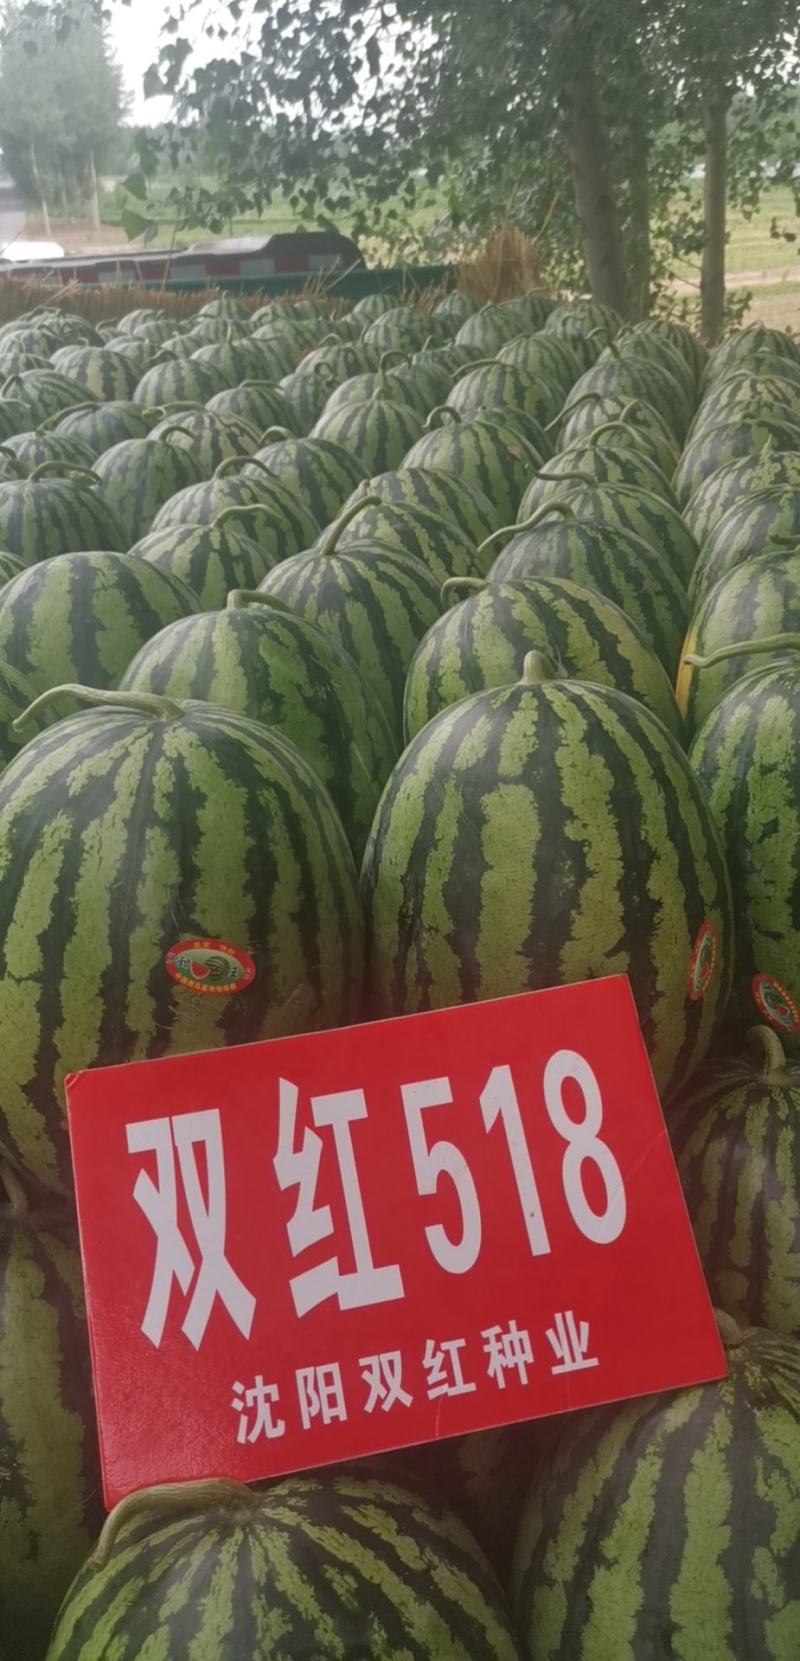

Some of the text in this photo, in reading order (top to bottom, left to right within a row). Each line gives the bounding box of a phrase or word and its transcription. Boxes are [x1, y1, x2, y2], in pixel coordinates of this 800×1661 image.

[126, 1050, 627, 1351] 双红518
[231, 1311, 599, 1444] 沈阳双红种业
